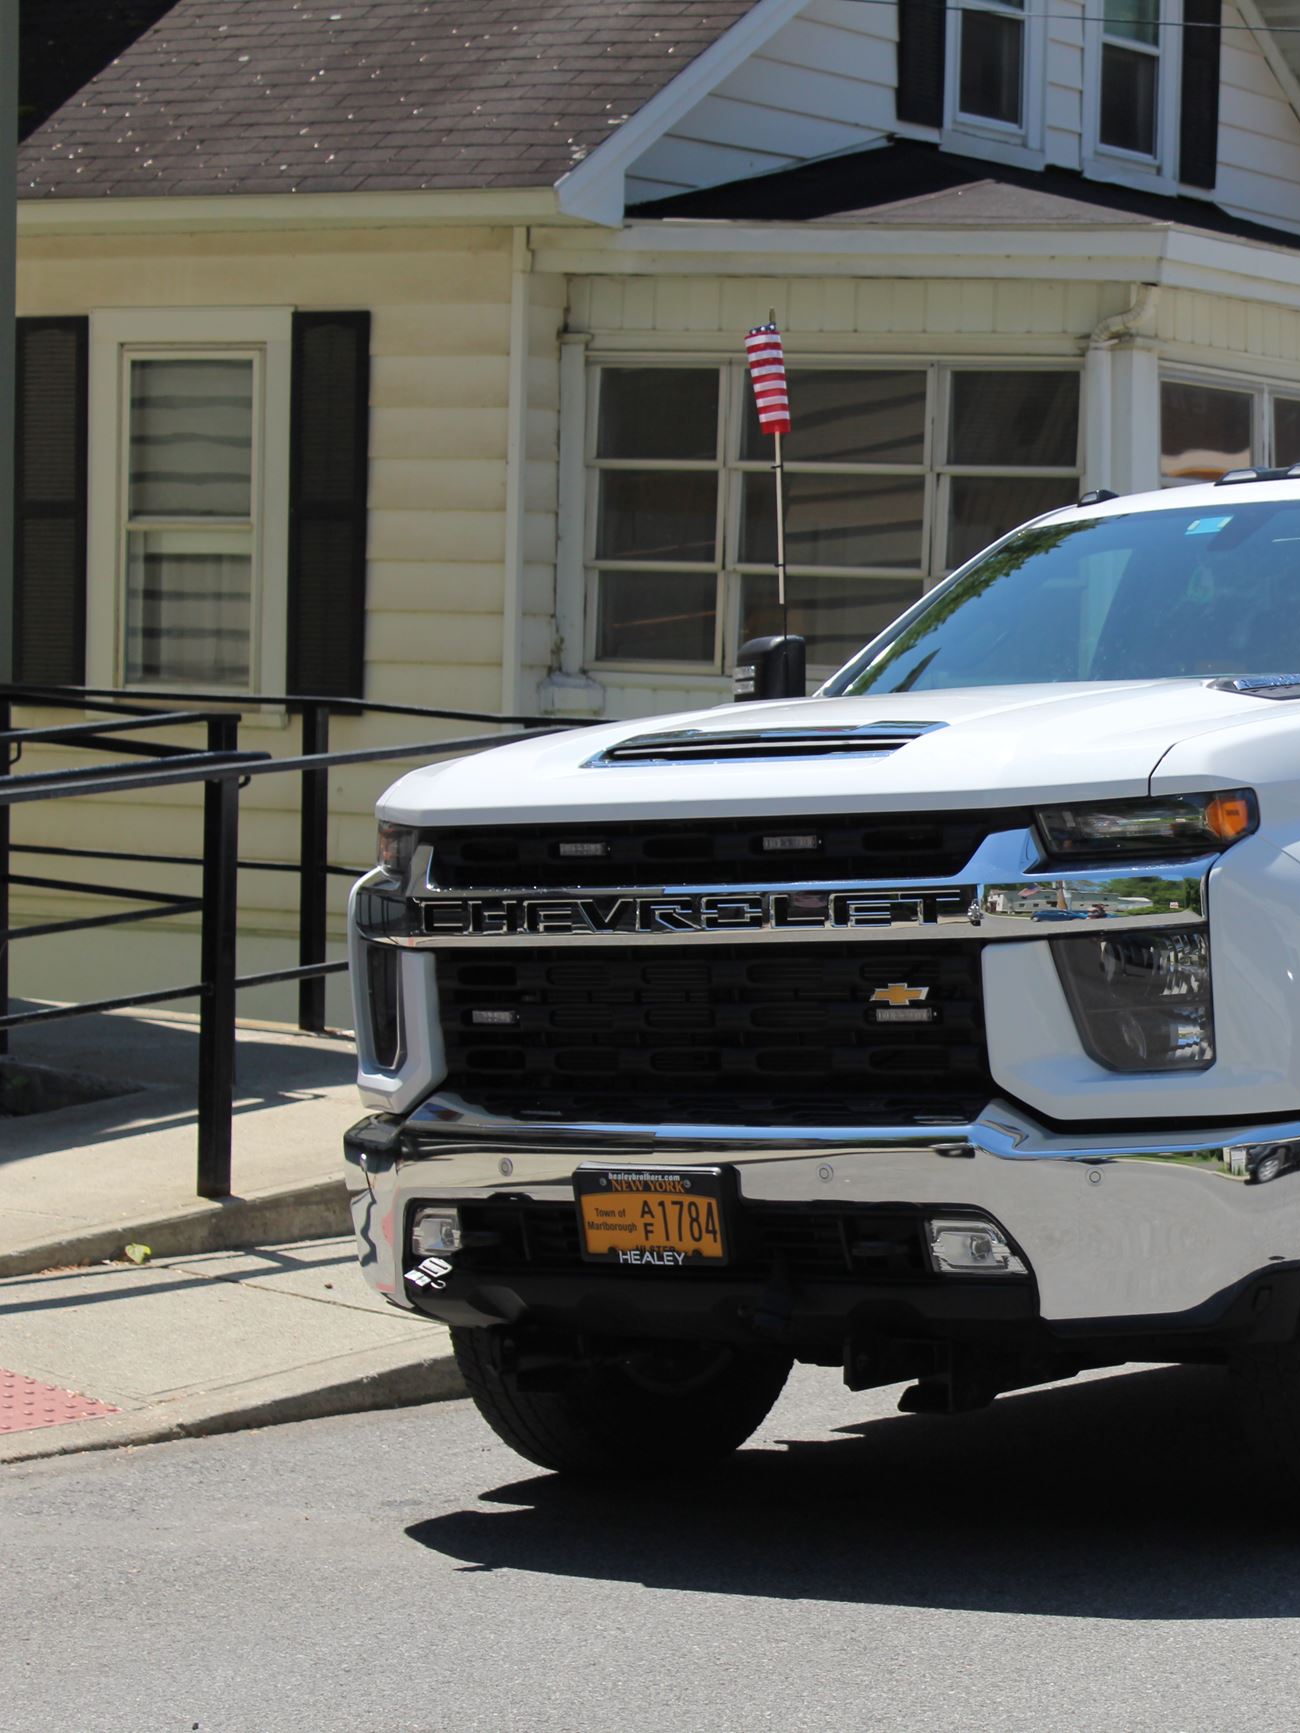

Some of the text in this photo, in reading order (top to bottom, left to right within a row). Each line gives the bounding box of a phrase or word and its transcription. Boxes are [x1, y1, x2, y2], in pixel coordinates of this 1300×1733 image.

[420, 890, 961, 934] CHEVROLET
[608, 1172, 680, 1182] healeybrothers.com
[611, 1180, 685, 1193] NEW YORK
[594, 1207, 626, 1218] Town of
[640, 1200, 655, 1218] A
[588, 1221, 637, 1233] Marlborough
[657, 1200, 718, 1243] 1784
[644, 1222, 655, 1241] F
[618, 1250, 685, 1265] HEALEY
